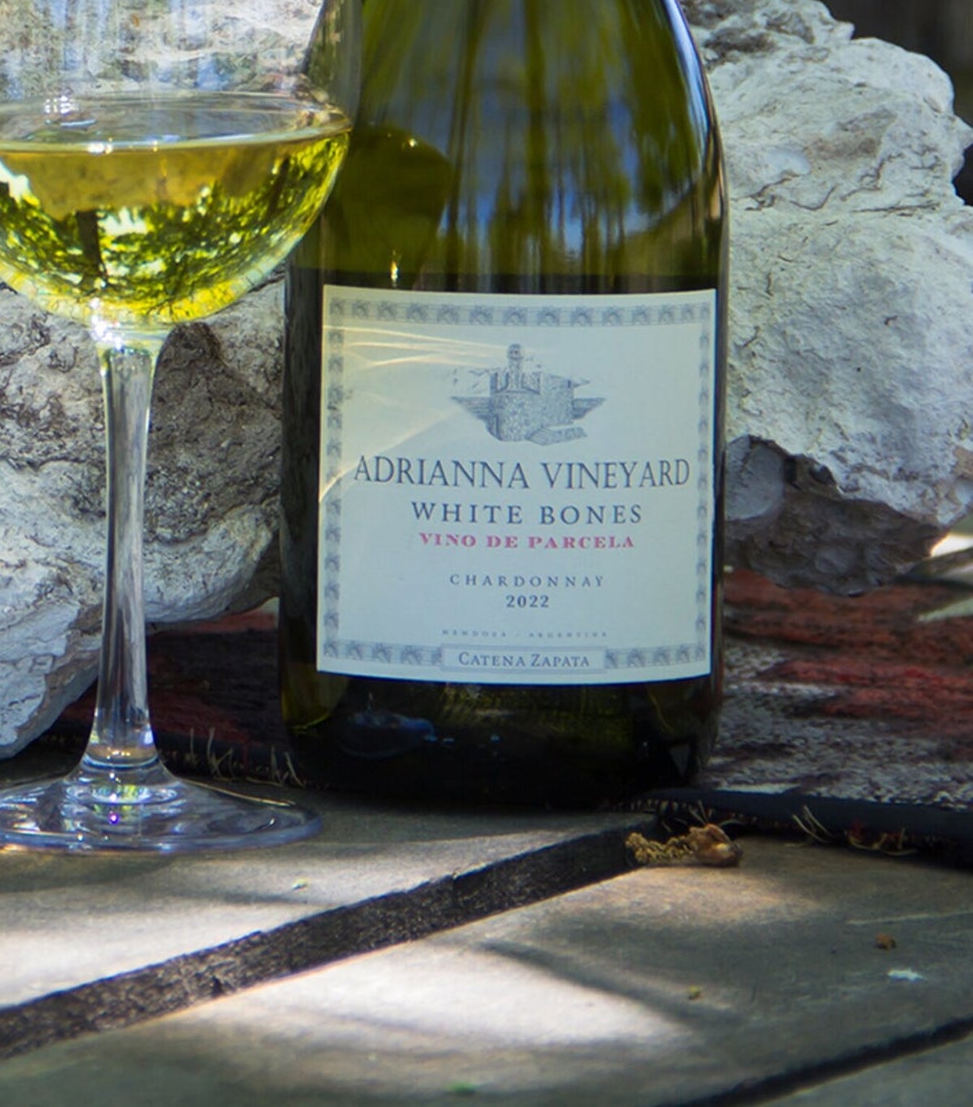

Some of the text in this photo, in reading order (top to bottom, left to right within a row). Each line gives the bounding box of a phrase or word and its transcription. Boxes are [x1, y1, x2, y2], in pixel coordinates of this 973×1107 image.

[354, 455, 690, 490] ADRIANNA VINEYARD
[411, 501, 642, 525] WHITE BONES
[418, 532, 634, 550] VINO DE PARCELA
[449, 573, 604, 588] CHARDONNAY
[505, 594, 550, 609] 2022
